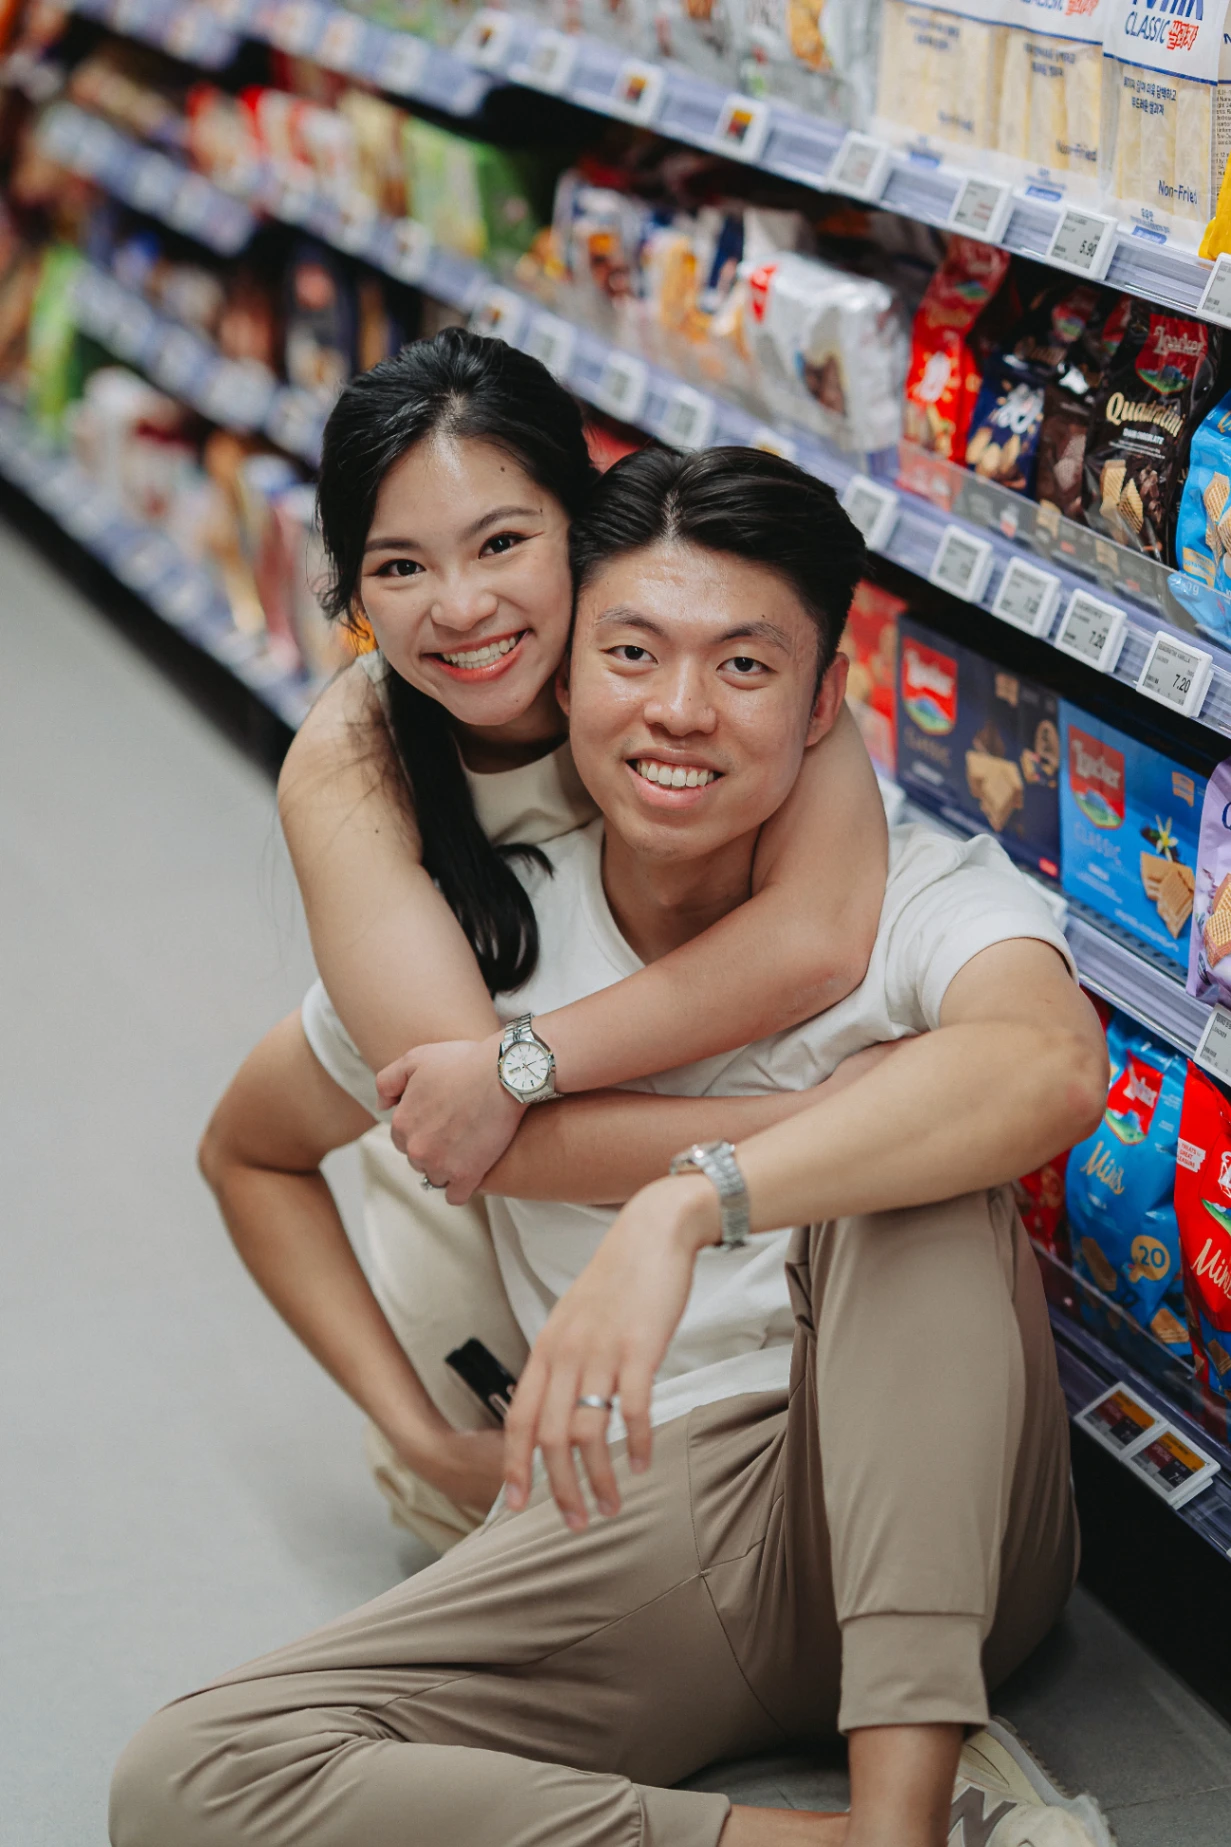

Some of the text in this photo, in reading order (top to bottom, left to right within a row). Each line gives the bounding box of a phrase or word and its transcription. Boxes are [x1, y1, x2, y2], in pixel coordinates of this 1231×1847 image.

[1125, 11, 1170, 44] CLASSIC
[1080, 240, 1098, 258] 5.90
[1153, 325, 1205, 357] Loacker
[1106, 392, 1185, 438] Quadratini
[1172, 673, 1191, 694] 7.20
[1138, 1245, 1166, 1269] 20
